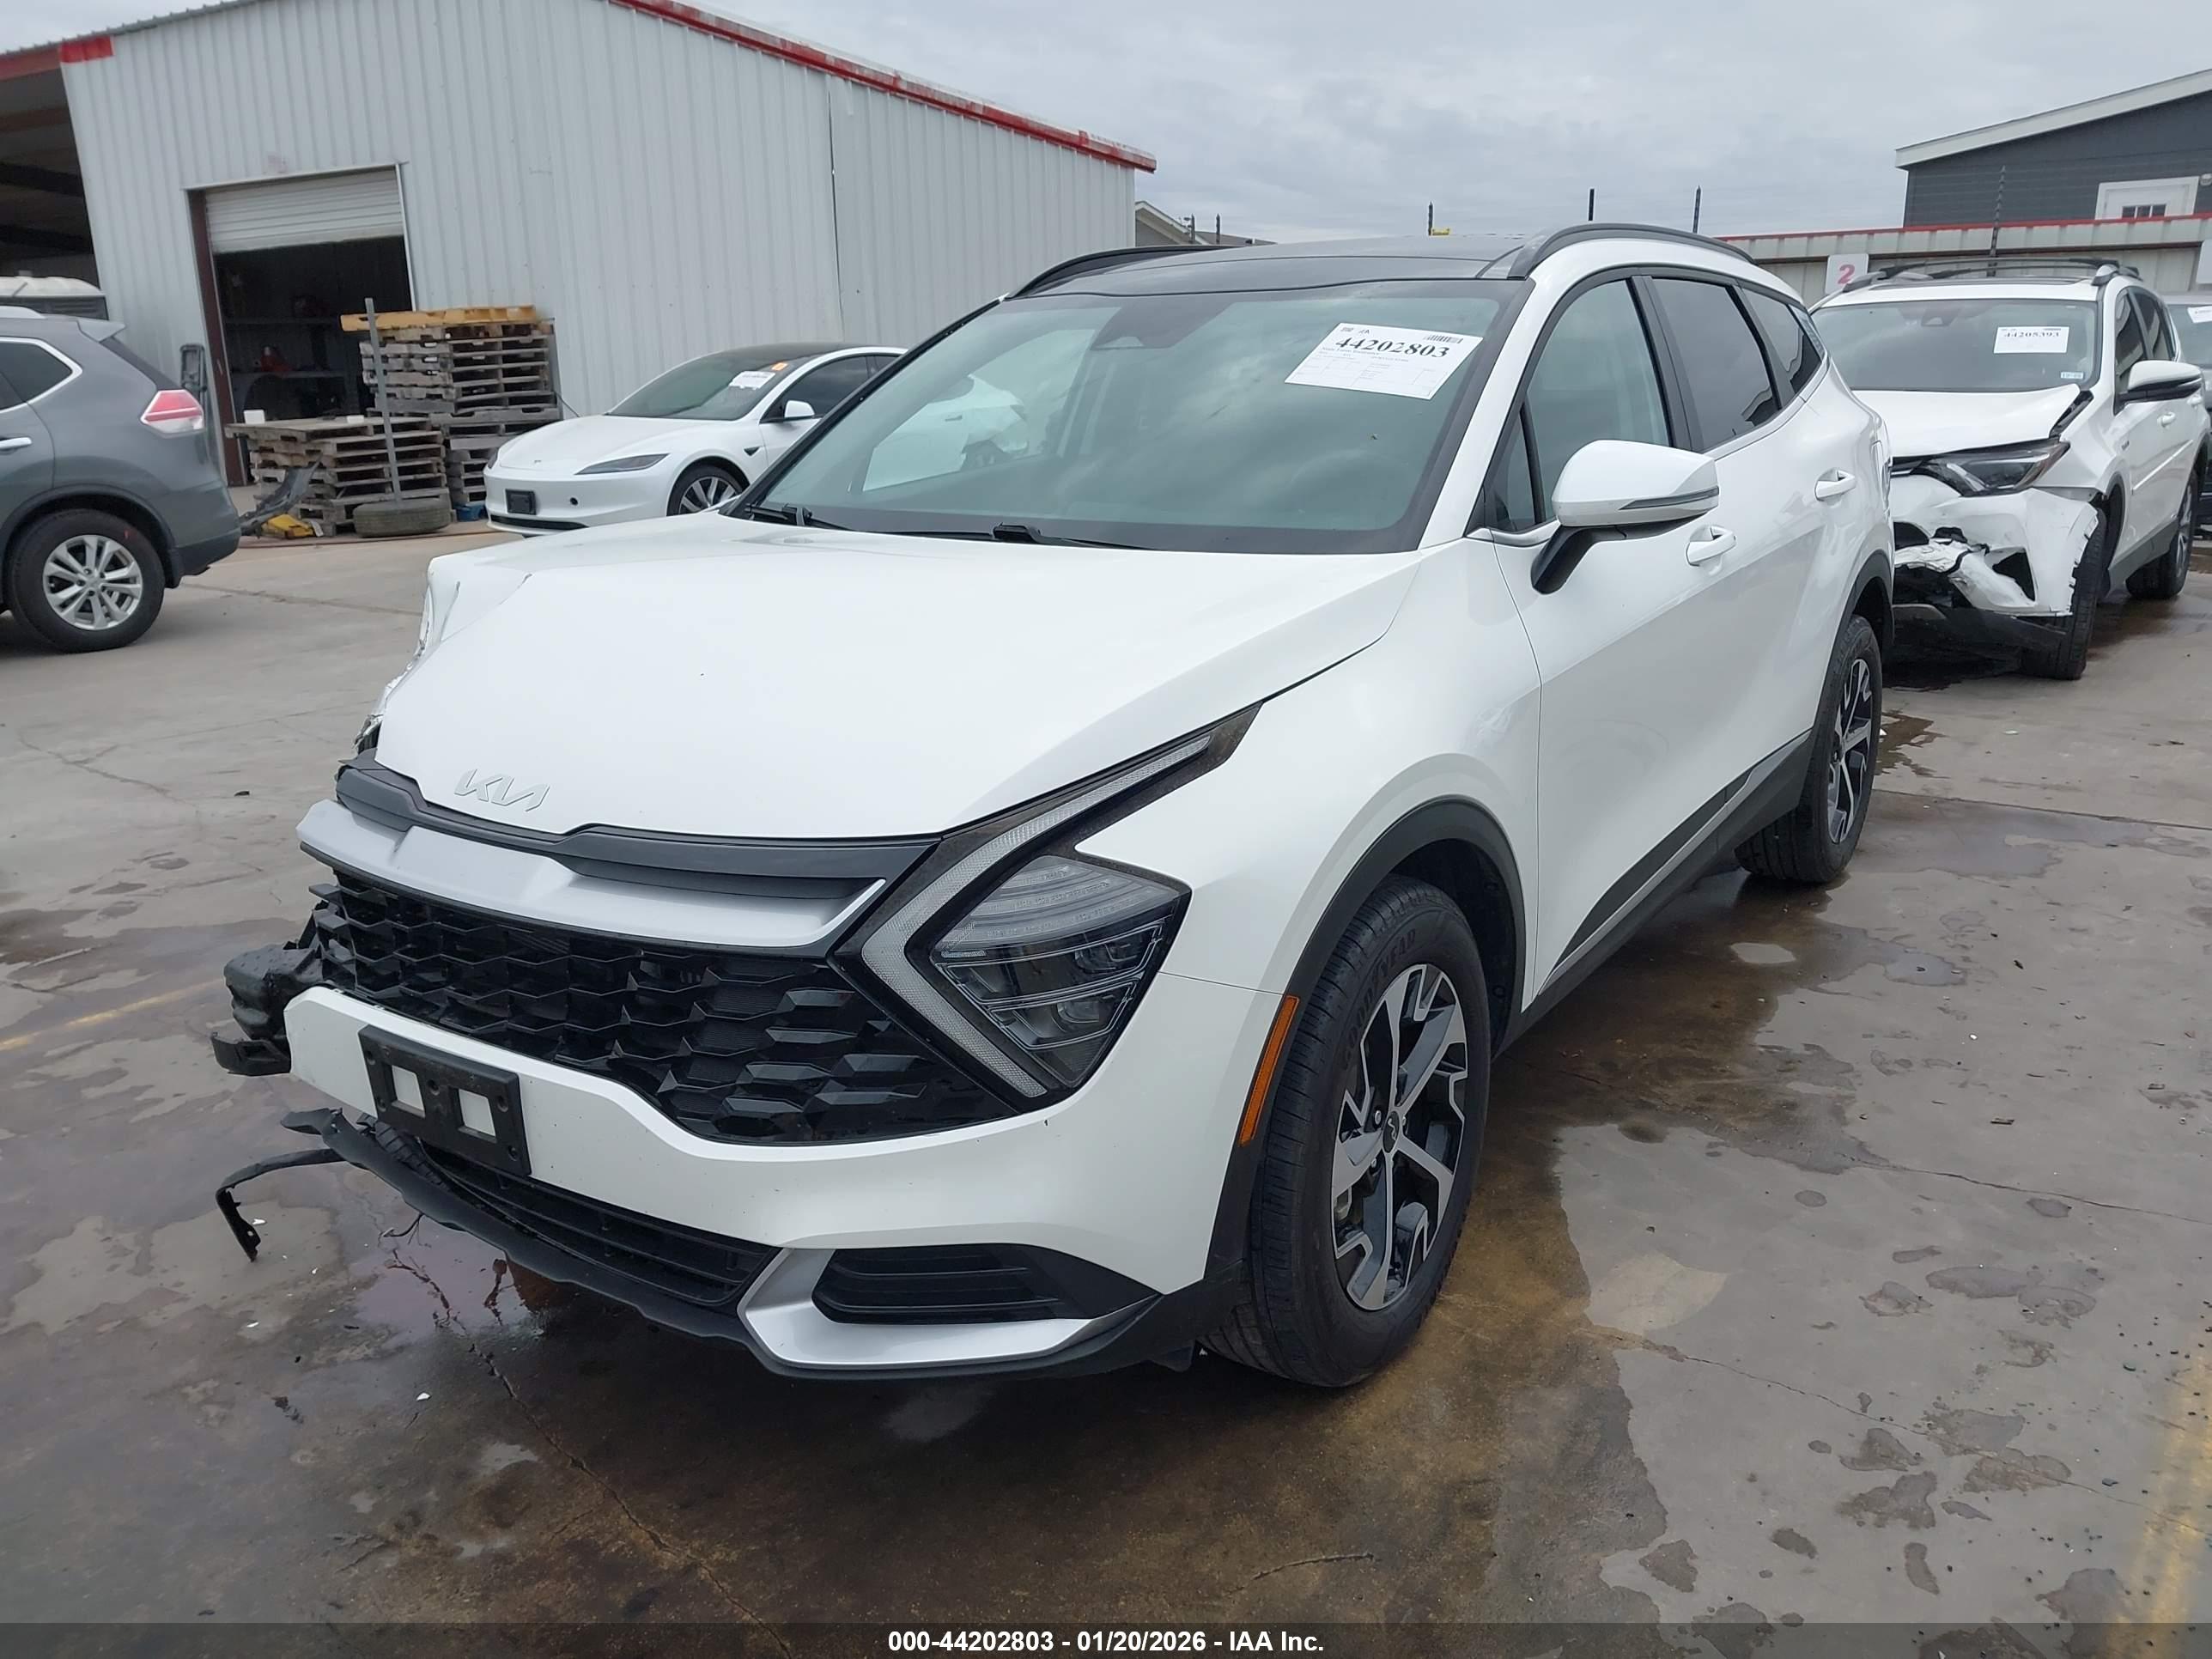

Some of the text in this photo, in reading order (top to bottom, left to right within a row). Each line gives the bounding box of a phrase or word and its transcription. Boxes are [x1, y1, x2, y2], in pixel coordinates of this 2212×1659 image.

[1838, 264, 1856, 284] 2
[1335, 337, 1450, 358] 44202803
[453, 769, 550, 812] KIA
